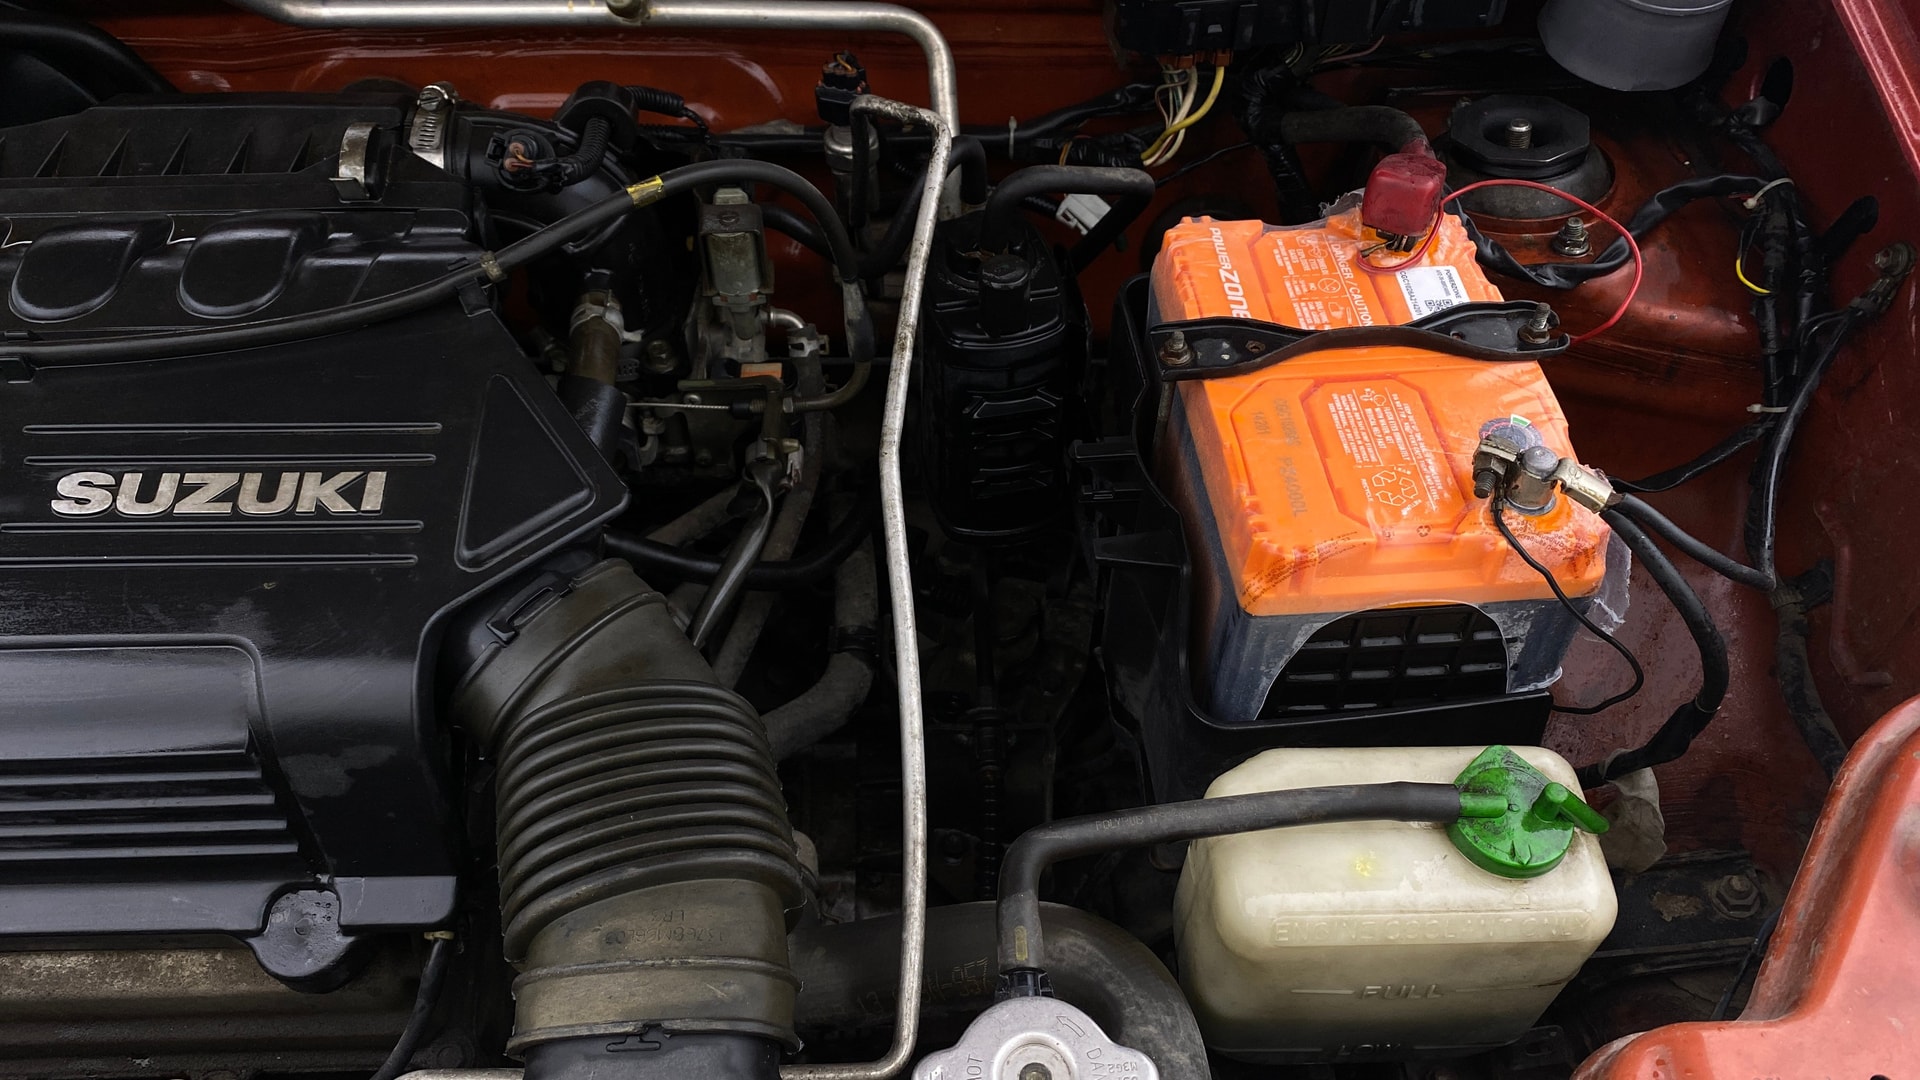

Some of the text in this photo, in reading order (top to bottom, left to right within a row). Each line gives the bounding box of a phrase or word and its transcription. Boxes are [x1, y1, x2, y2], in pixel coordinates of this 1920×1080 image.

[1331, 243, 1354, 279] DANGER
[1349, 285, 1375, 326] CAUTION
[51, 471, 387, 517] SUZUKI
[1275, 915, 1593, 942] ENGINE COOLANT ONLY
[1361, 984, 1444, 1000] FULL
